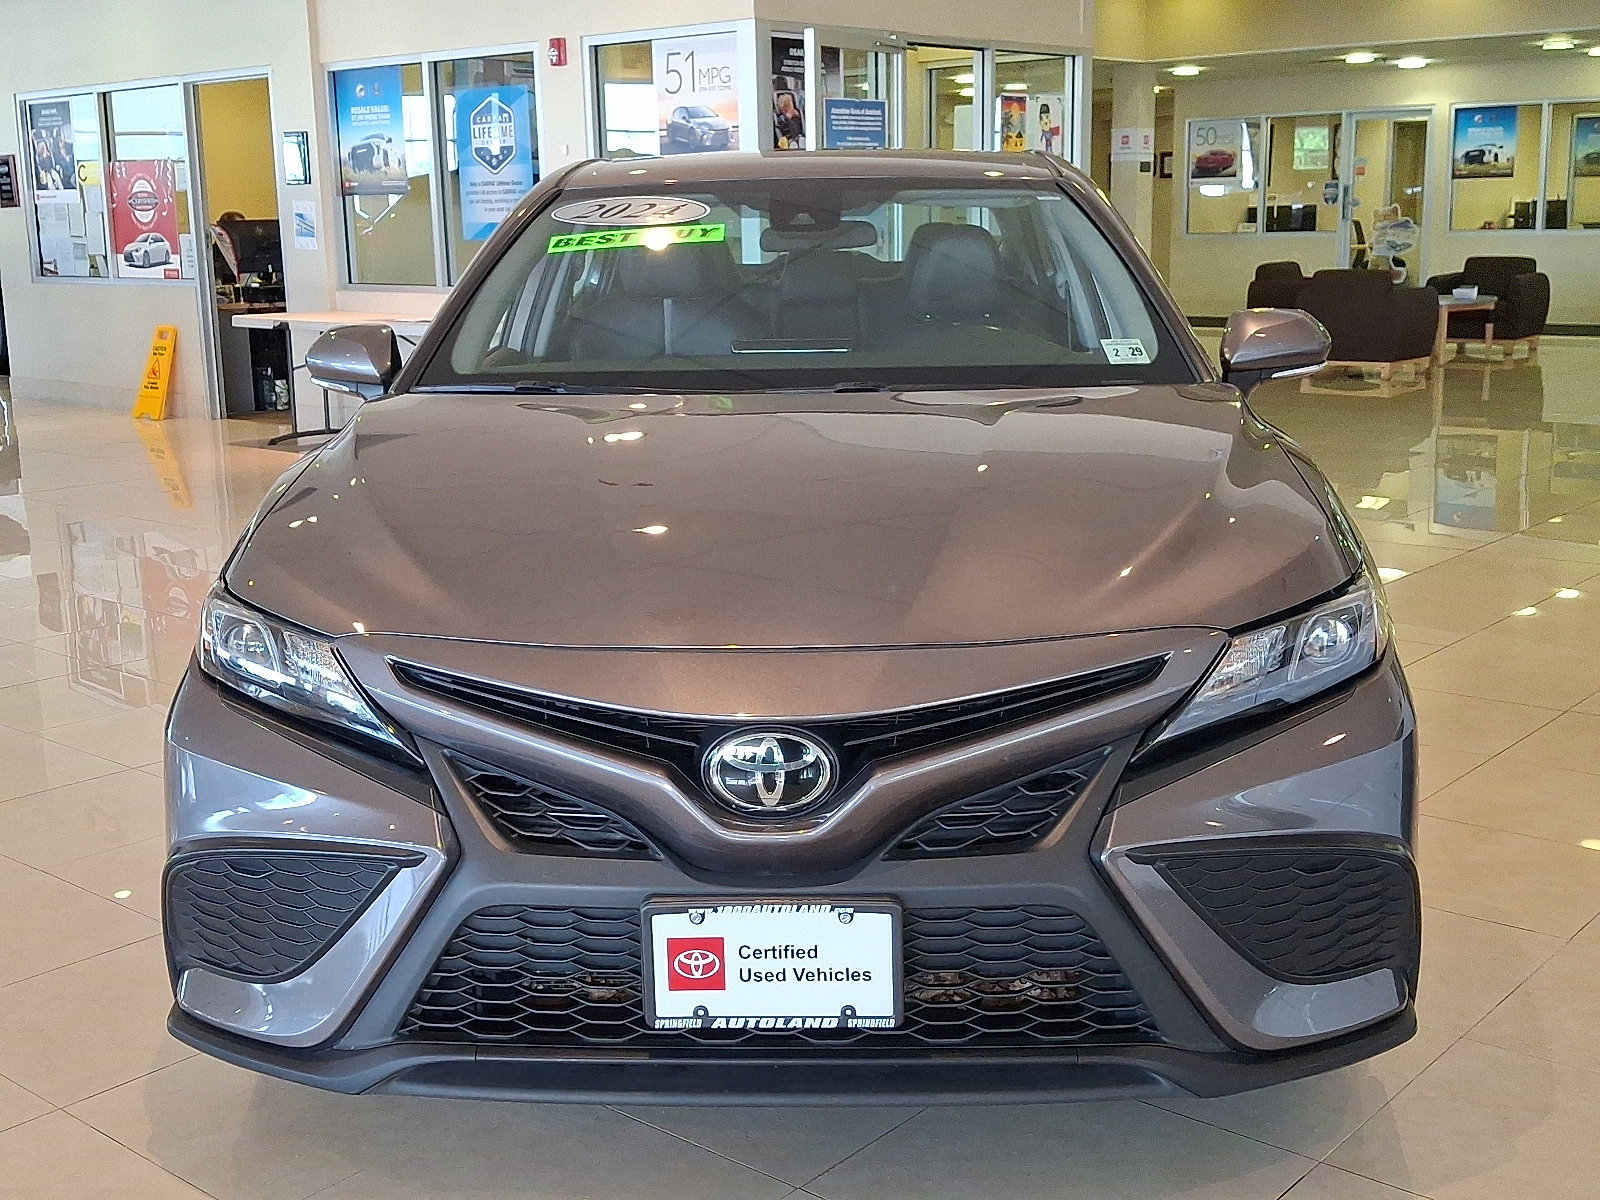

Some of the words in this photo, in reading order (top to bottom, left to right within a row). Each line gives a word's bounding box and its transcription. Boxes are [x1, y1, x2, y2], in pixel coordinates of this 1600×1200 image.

[665, 50, 695, 95] 51
[698, 66, 731, 85] MPG
[1195, 126, 1217, 146] 50
[551, 231, 638, 249] BEST
[665, 227, 720, 243] UY
[1112, 347, 1121, 357] 2
[1128, 346, 1144, 357] 29
[738, 945, 818, 960] Certified
[739, 967, 787, 982] Used
[793, 967, 872, 982] Vehicles
[654, 1018, 703, 1029] SPRINGFIELD
[711, 1017, 840, 1029] AUTOLAND
[847, 1018, 896, 1028] SPRINGFIELD
